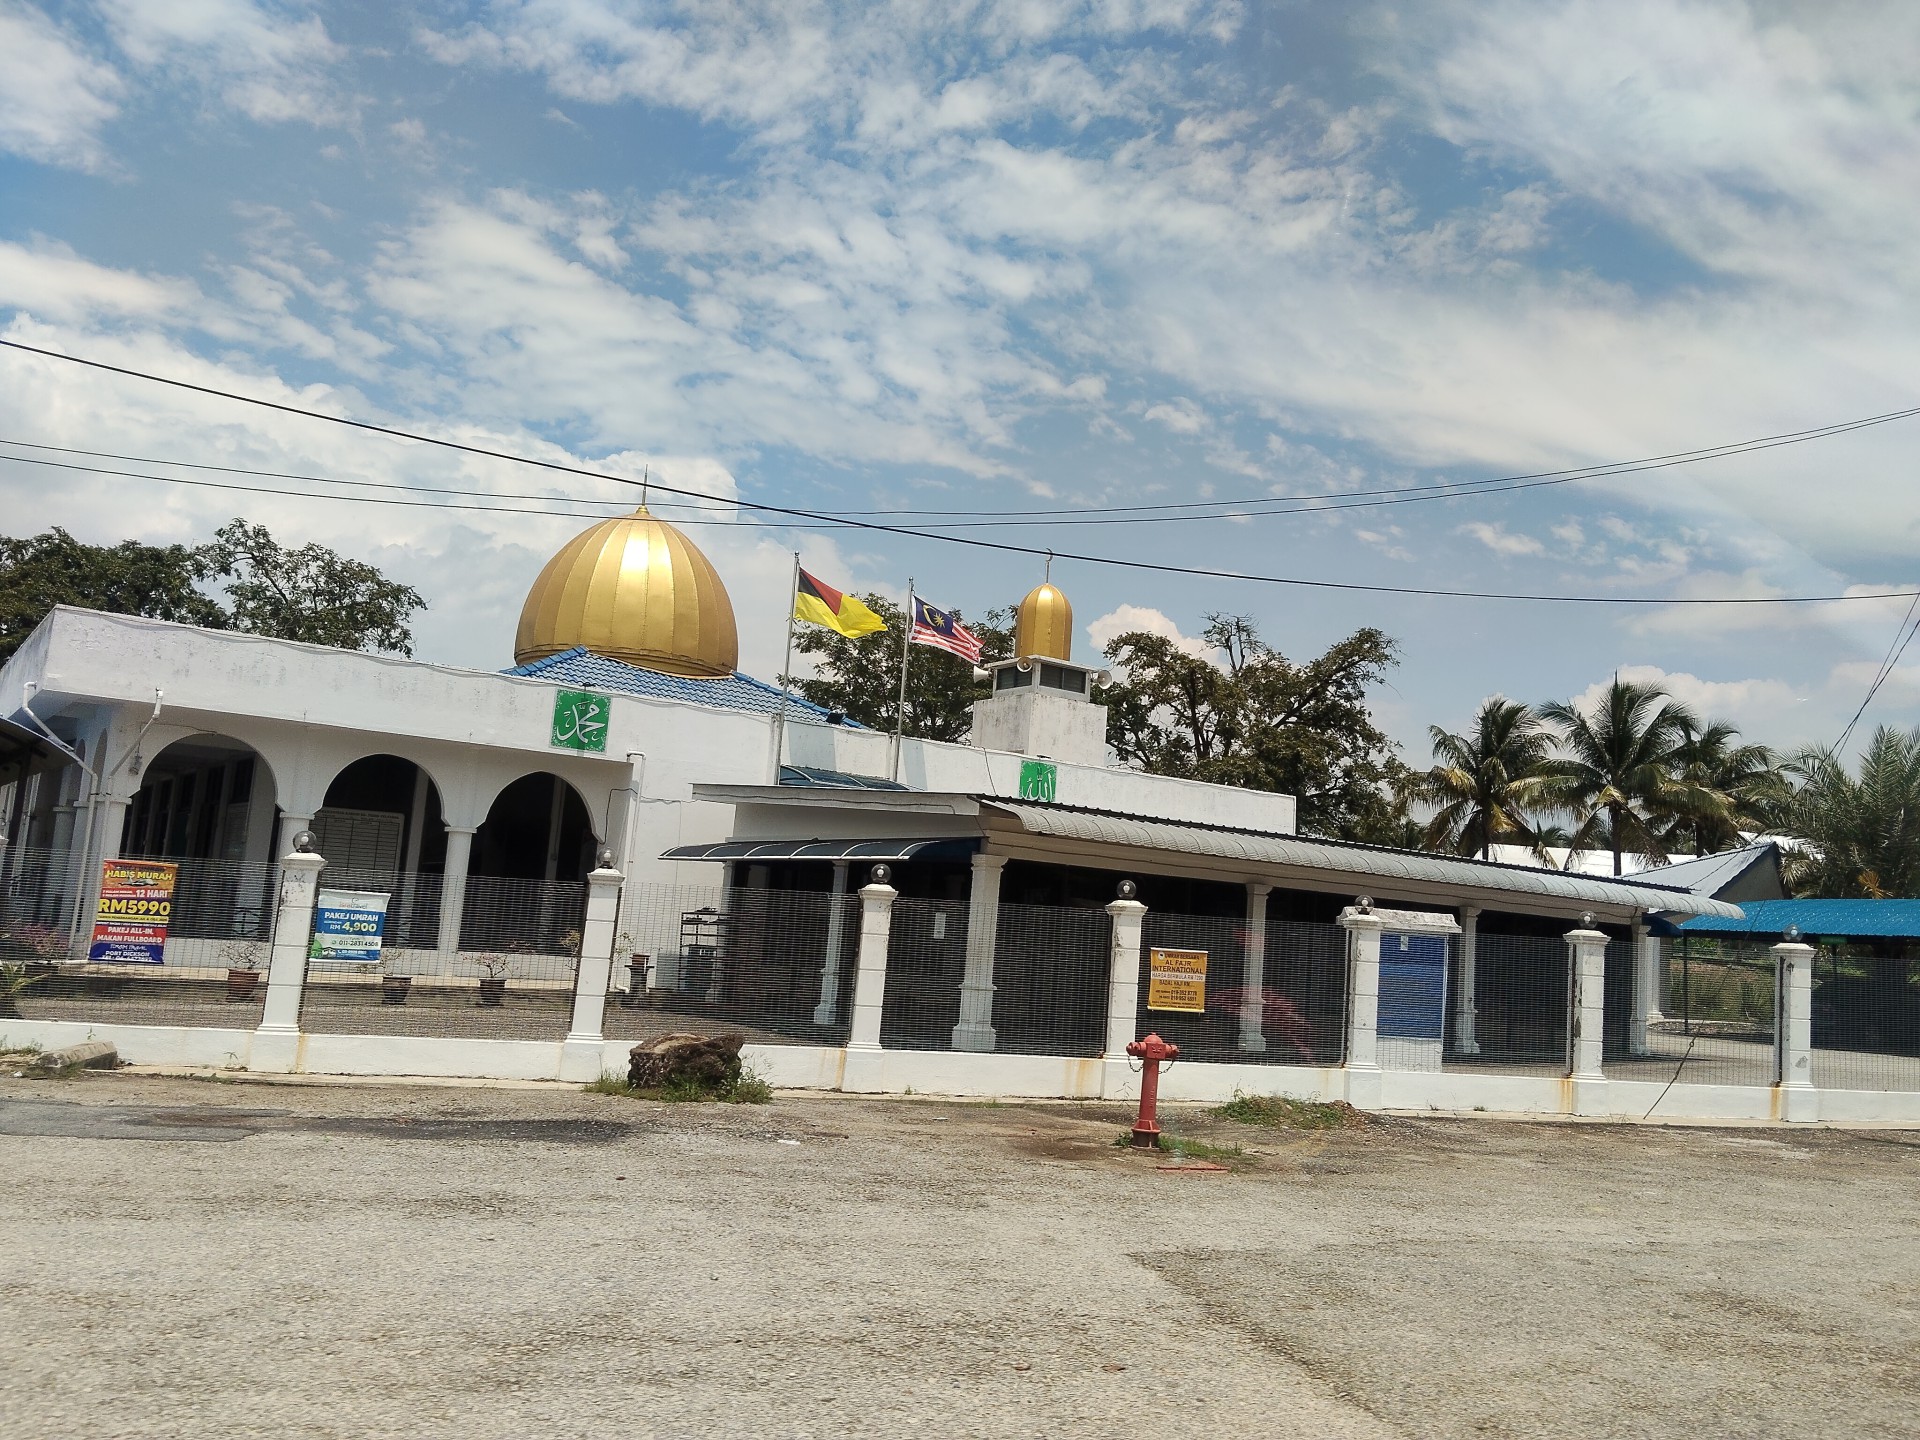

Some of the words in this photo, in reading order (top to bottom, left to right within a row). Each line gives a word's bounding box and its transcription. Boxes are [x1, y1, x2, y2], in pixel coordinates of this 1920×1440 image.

[105, 870, 135, 879] HABIS
[137, 871, 173, 880] MURAH
[136, 889, 145, 898] 12
[147, 890, 168, 898] HARI
[99, 898, 171, 916] RM5990
[324, 912, 349, 920] PAKEJ
[350, 913, 379, 921] UMRAH
[107, 926, 130, 934] PAKEJ
[342, 922, 377, 933] 4,900
[97, 934, 122, 942] MAKAN
[123, 935, 163, 943] FULLBOARD
[1152, 965, 1203, 974] INTERNATIONAL
